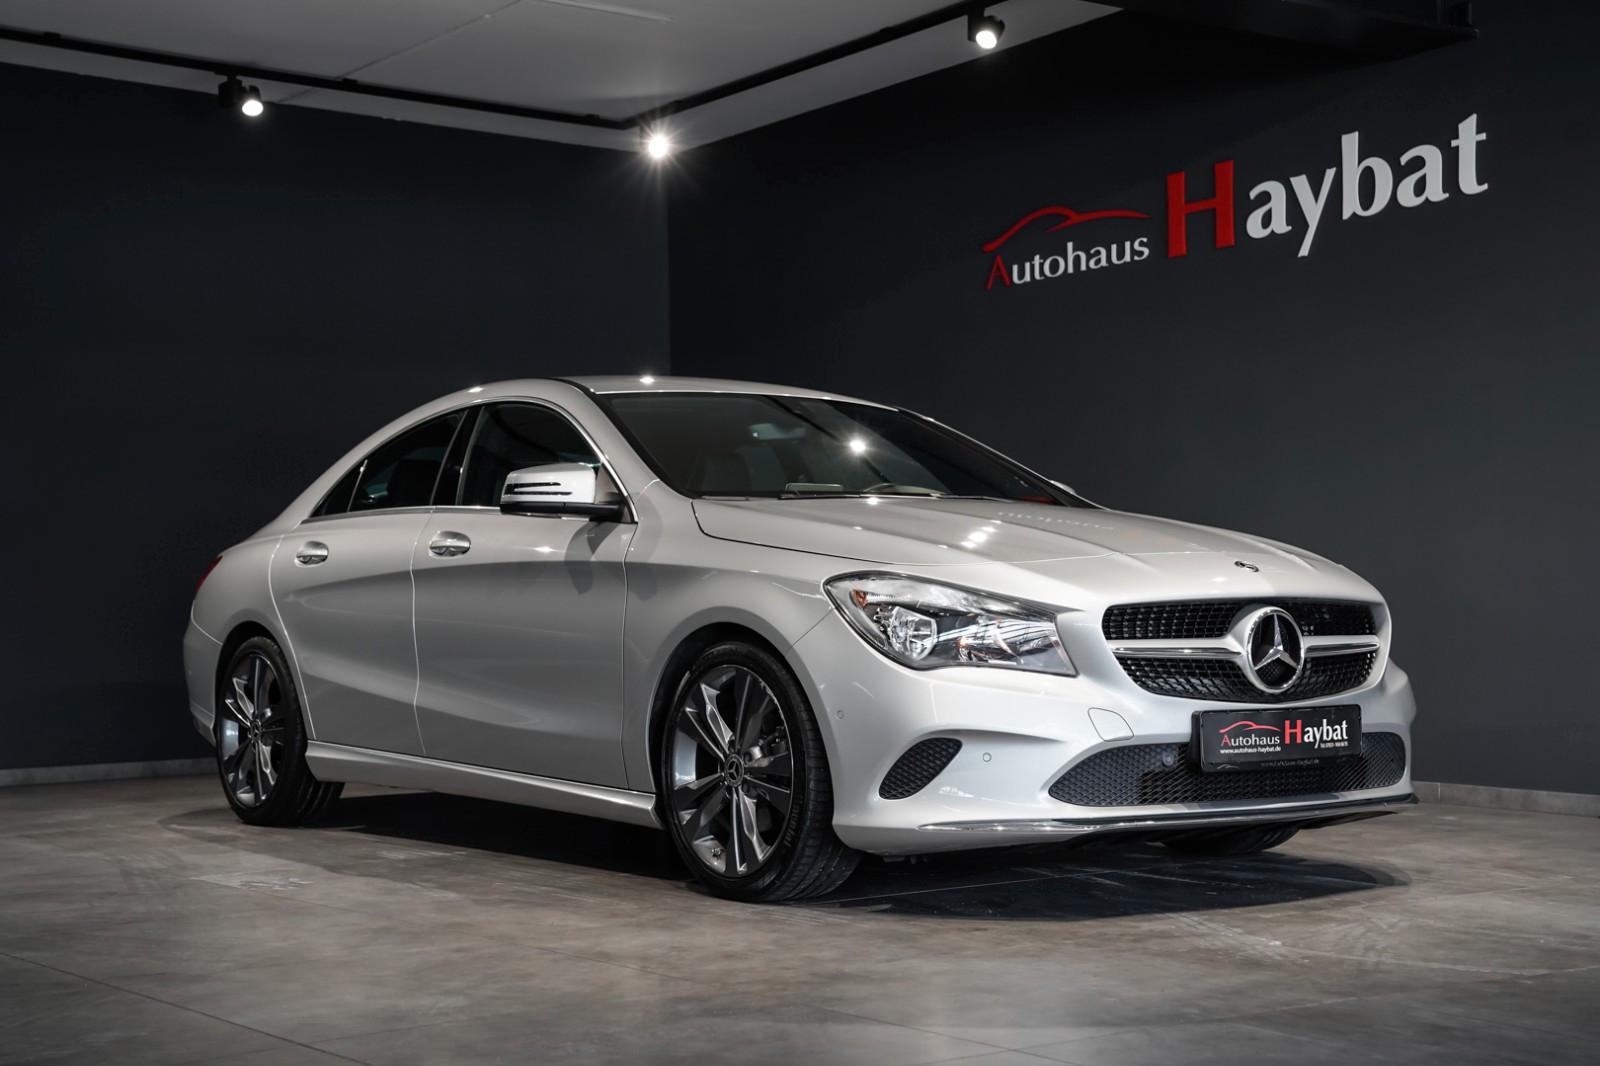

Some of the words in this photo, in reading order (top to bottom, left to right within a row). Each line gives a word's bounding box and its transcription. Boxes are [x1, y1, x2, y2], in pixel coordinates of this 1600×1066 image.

[986, 236, 1150, 290] Autohaus
[1166, 112, 1489, 258] Haybat
[1221, 734, 1280, 747] Autohaus
[1284, 719, 1348, 749] Haybat
[1219, 745, 1282, 755] www.autohaus-haybat.de
